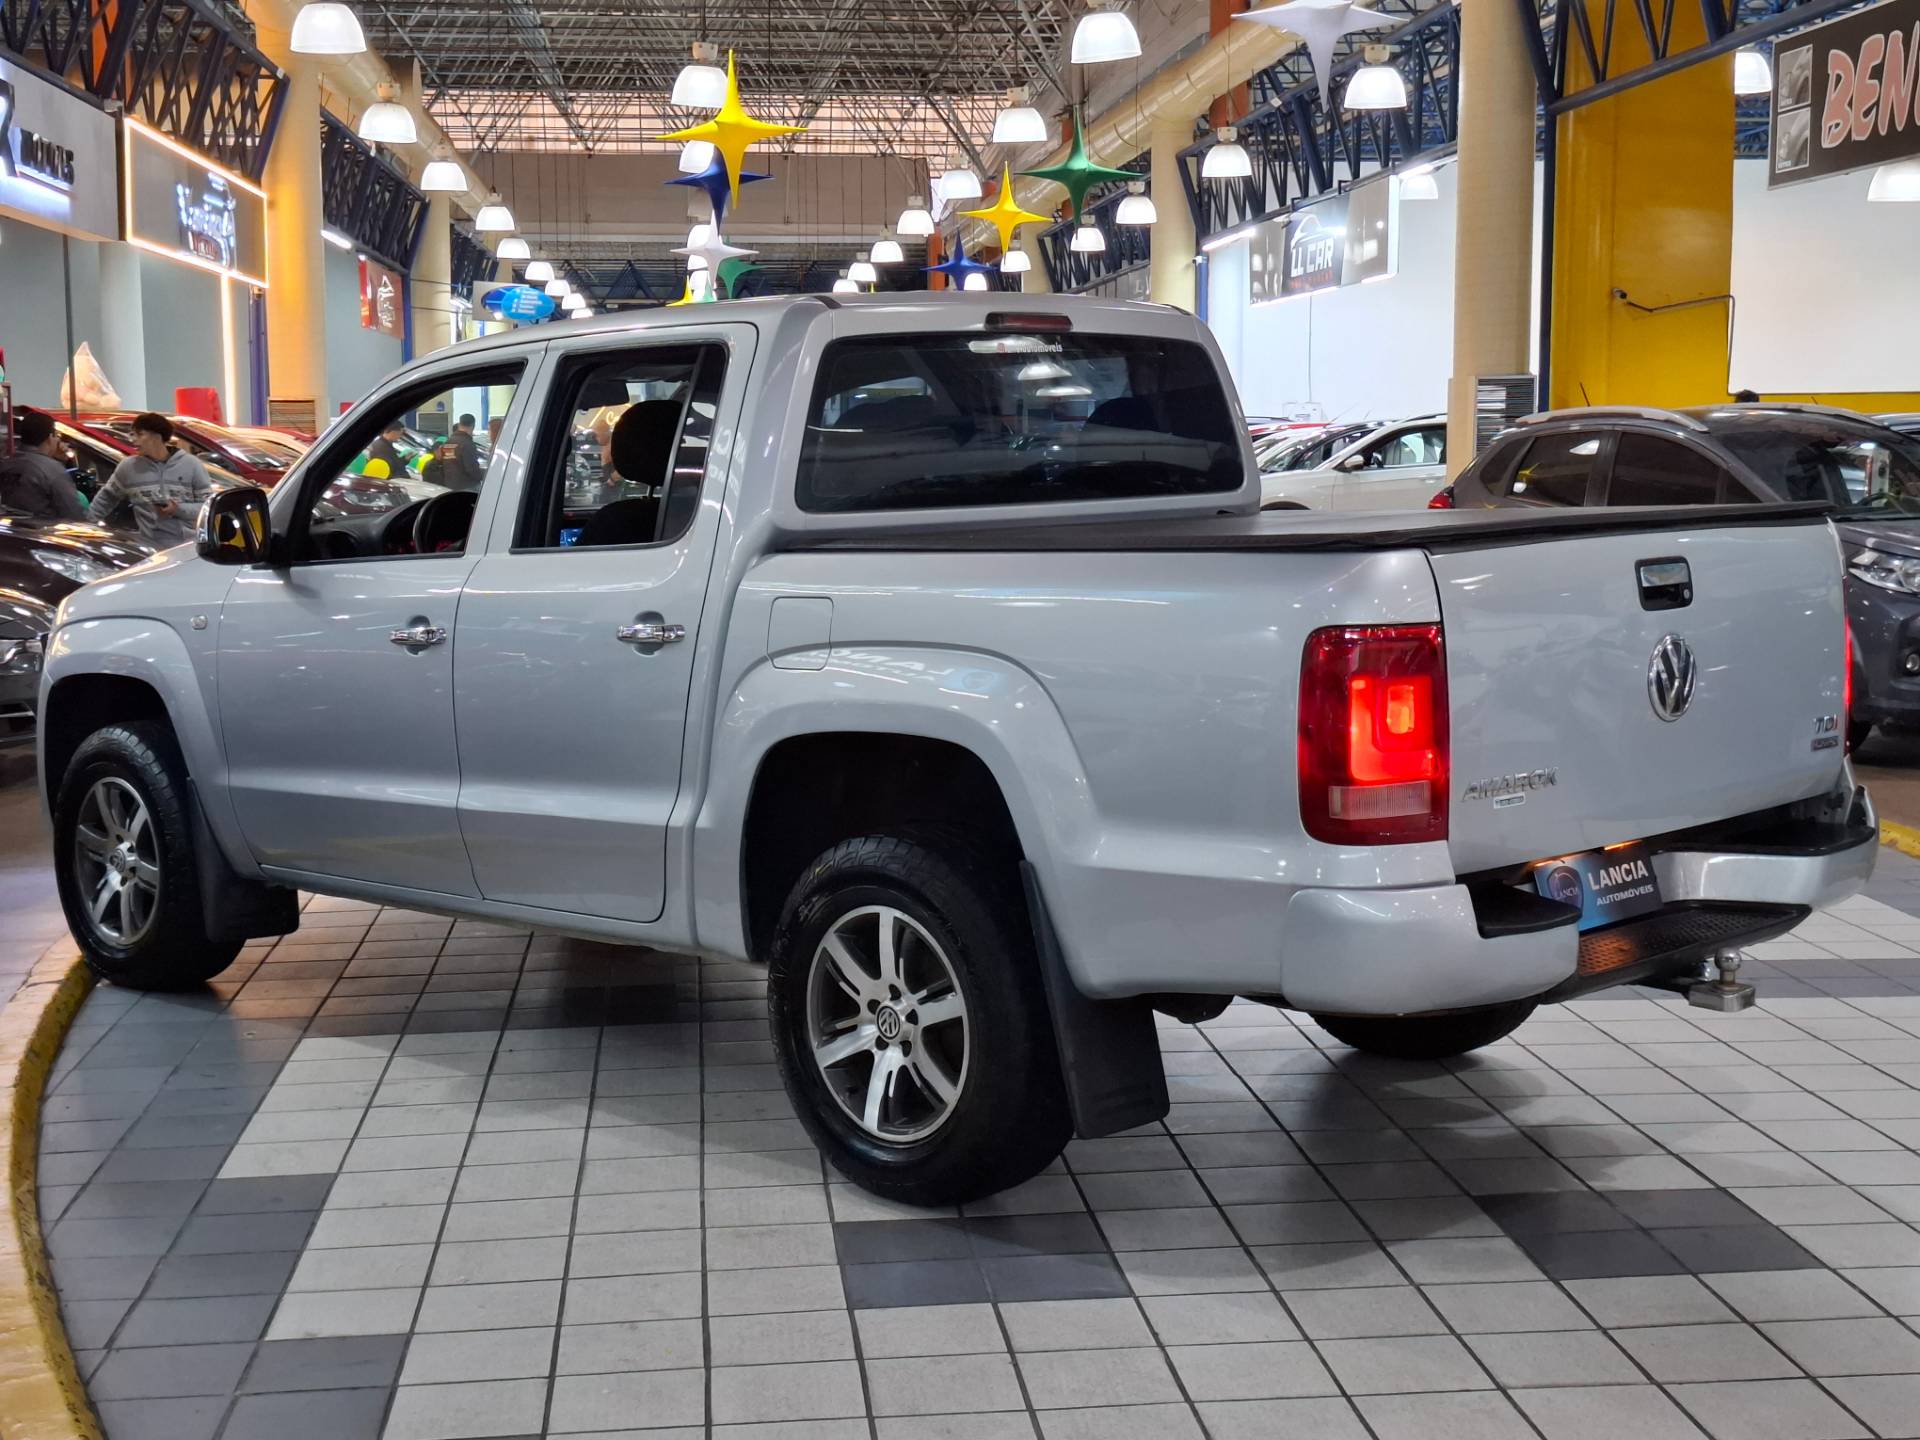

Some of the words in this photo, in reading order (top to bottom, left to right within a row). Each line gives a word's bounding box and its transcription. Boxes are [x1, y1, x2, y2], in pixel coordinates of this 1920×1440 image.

[1821, 20, 1920, 149] BEN
[1306, 238, 1334, 273] CAR
[1462, 766, 1559, 803] AMAROK
[1587, 859, 1649, 891] LANCIA
[1596, 883, 1654, 907] AUTOMÓVEIS
